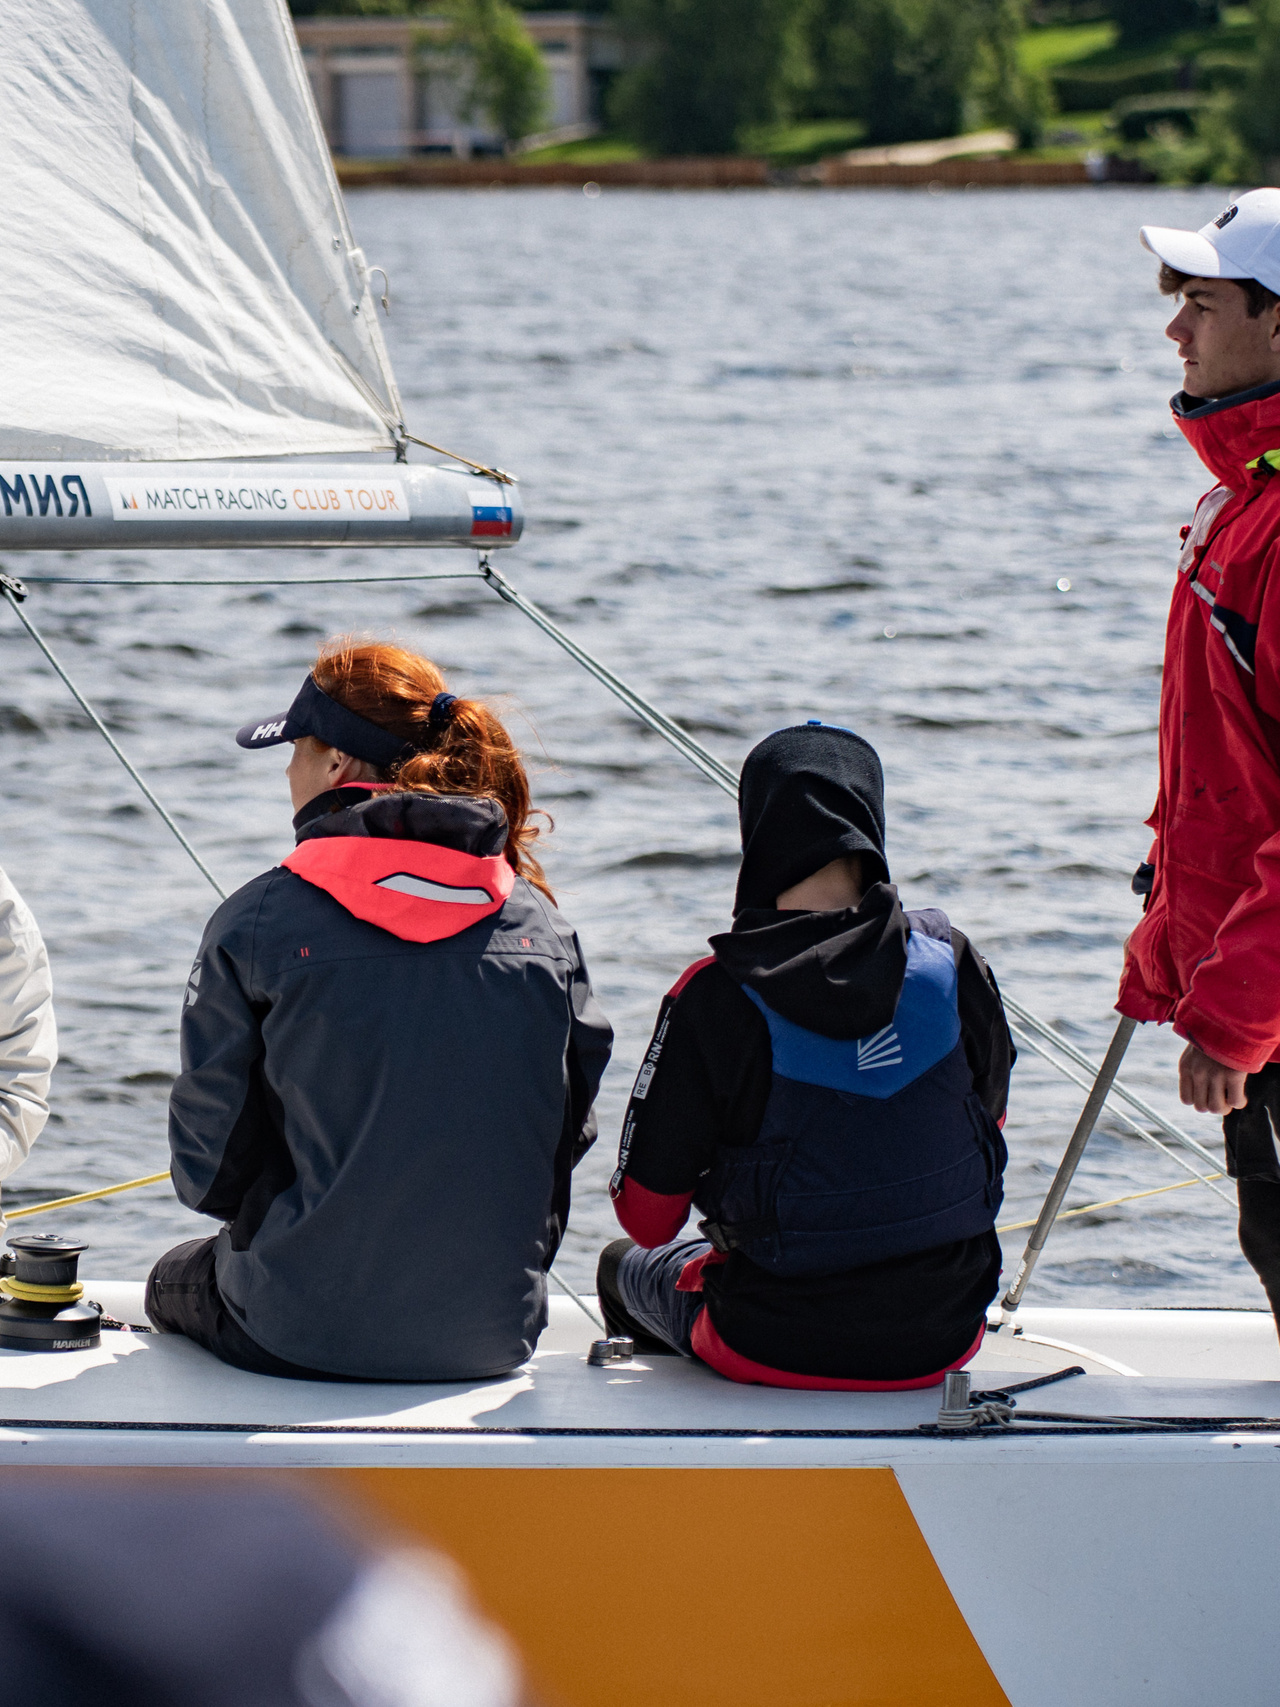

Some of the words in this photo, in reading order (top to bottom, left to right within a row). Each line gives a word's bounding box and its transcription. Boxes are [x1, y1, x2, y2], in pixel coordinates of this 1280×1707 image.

[144, 488, 212, 510] MATCH
[215, 488, 287, 510] RACING
[292, 488, 341, 510] CLUB
[345, 489, 400, 511] TOUR
[250, 720, 287, 741] HH
[52, 1338, 91, 1349] HARKEN
